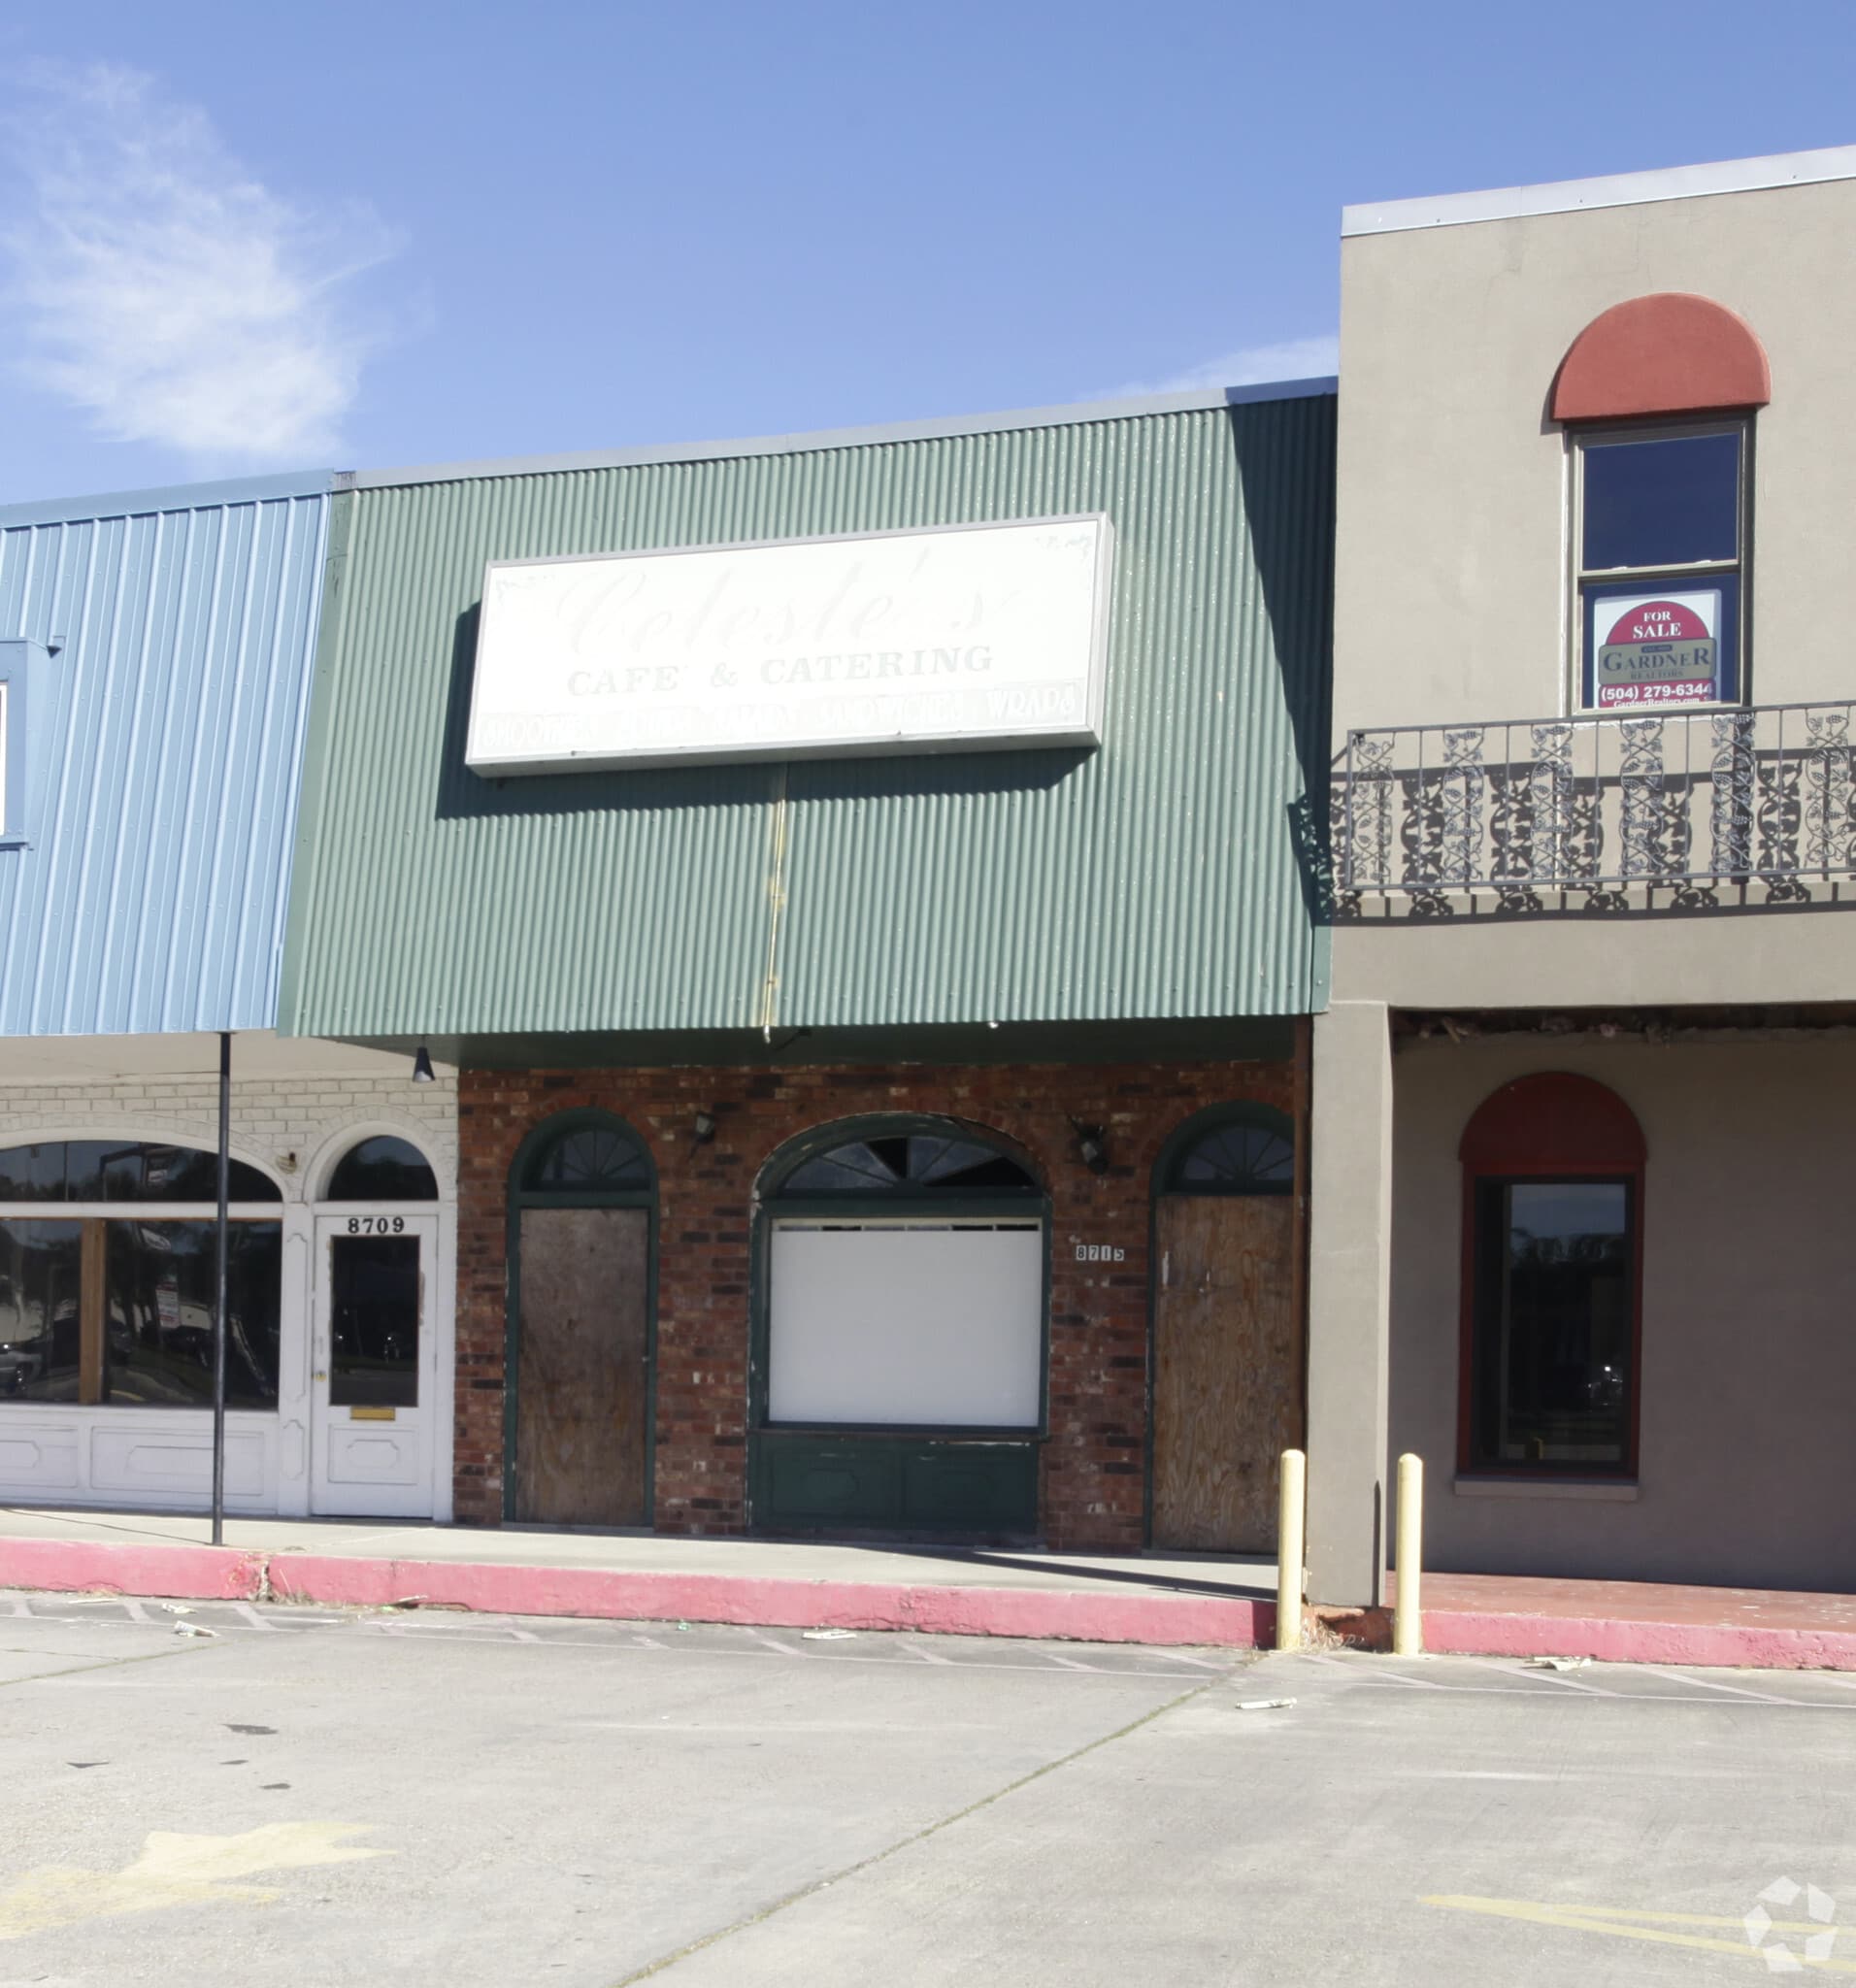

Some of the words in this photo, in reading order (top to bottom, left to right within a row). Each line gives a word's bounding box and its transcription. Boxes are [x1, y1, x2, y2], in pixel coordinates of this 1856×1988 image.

[1643, 611, 1672, 622] FOR
[1633, 622, 1681, 640] SALE
[709, 661, 739, 687] &
[759, 644, 994, 685] CATERING
[1603, 647, 1710, 672] GARDNER
[1601, 685, 1640, 702] (504)
[1643, 682, 1712, 698] 279-6344
[348, 1216, 405, 1235] 8709
[1077, 1245, 1124, 1260] 8715
